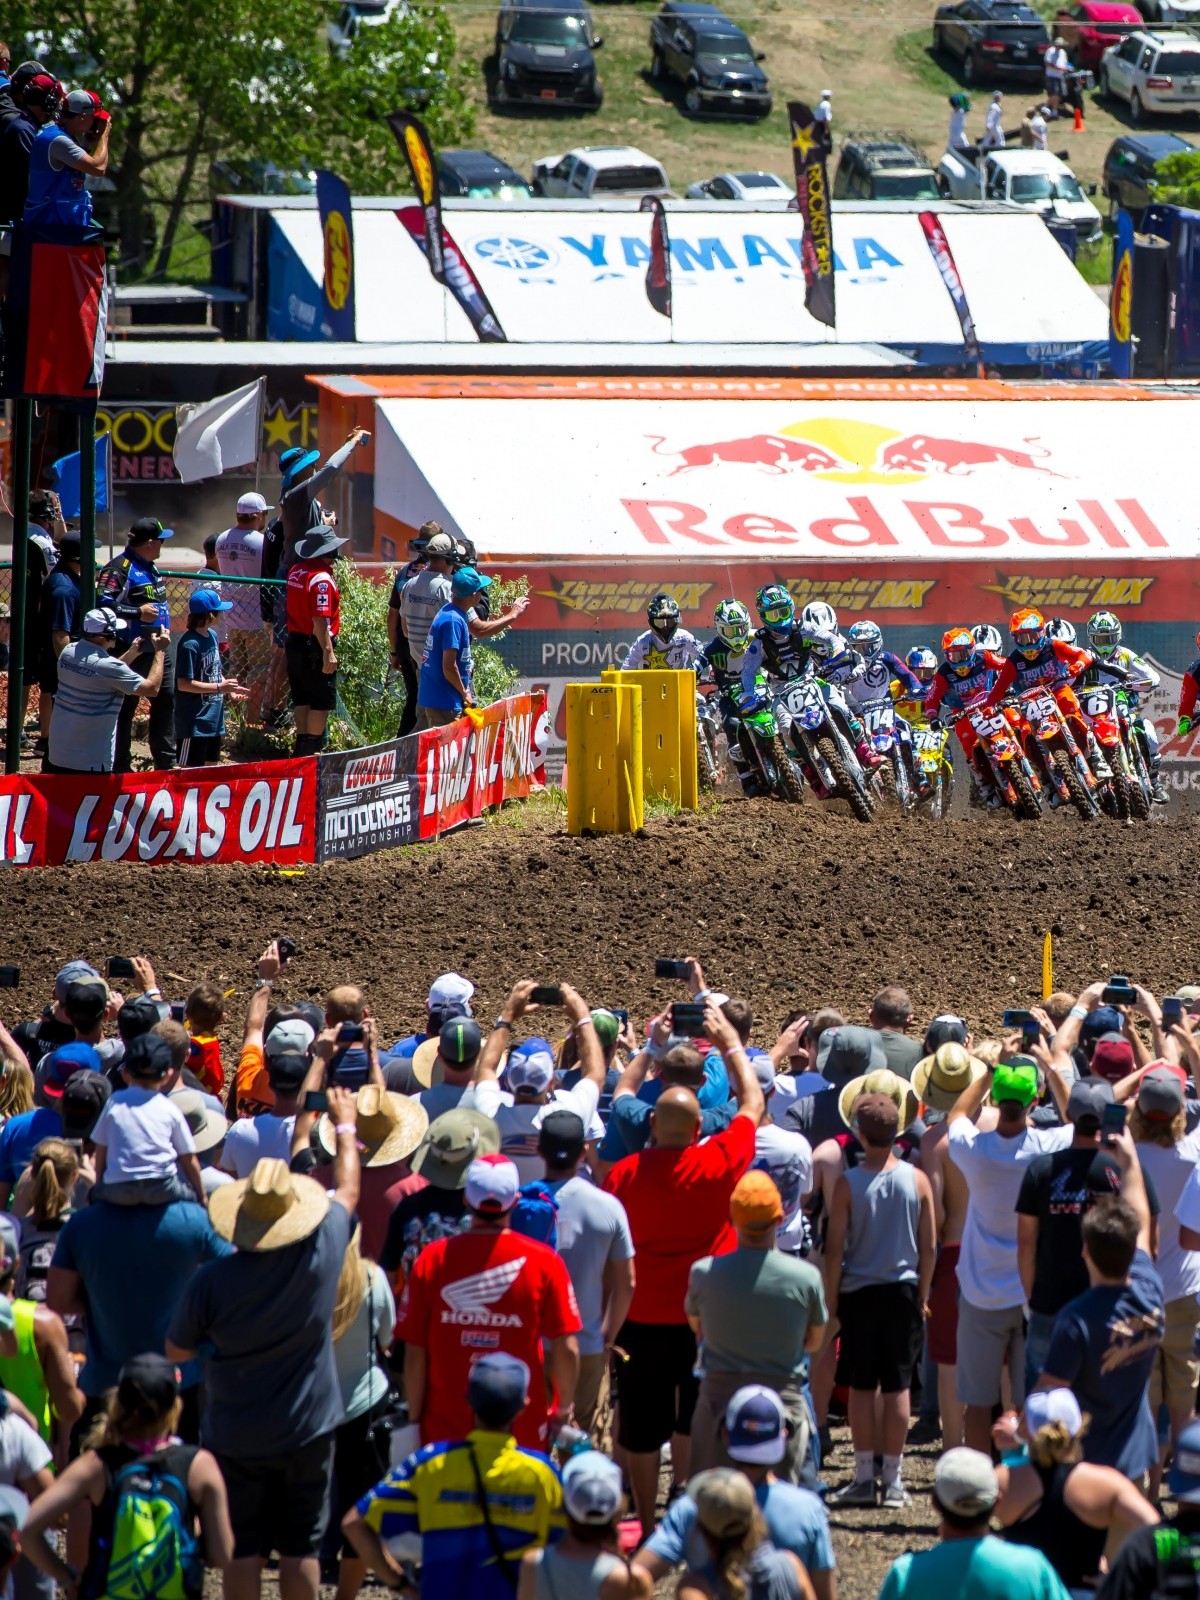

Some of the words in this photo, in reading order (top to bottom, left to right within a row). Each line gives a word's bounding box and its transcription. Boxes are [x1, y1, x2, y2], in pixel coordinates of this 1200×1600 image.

[618, 496, 899, 548] Red
[902, 498, 1170, 548] Bull
[1004, 574, 1100, 592] Thunder
[1017, 590, 1092, 608] Valley
[1091, 577, 1154, 606] MX
[863, 708, 894, 730] 114
[1026, 695, 1056, 721] 45
[1088, 694, 1108, 716] 6
[346, 755, 380, 789] LUCAS
[379, 753, 395, 782] OIL
[423, 731, 474, 817] LUCAS
[357, 788, 380, 803] PRO
[64, 784, 231, 863] LUCAS
[239, 777, 304, 853] OIL
[325, 794, 411, 842] MOTOCROSS
[324, 824, 412, 856] CHAMPIONSHIP
[440, 1310, 523, 1328] HONDA
